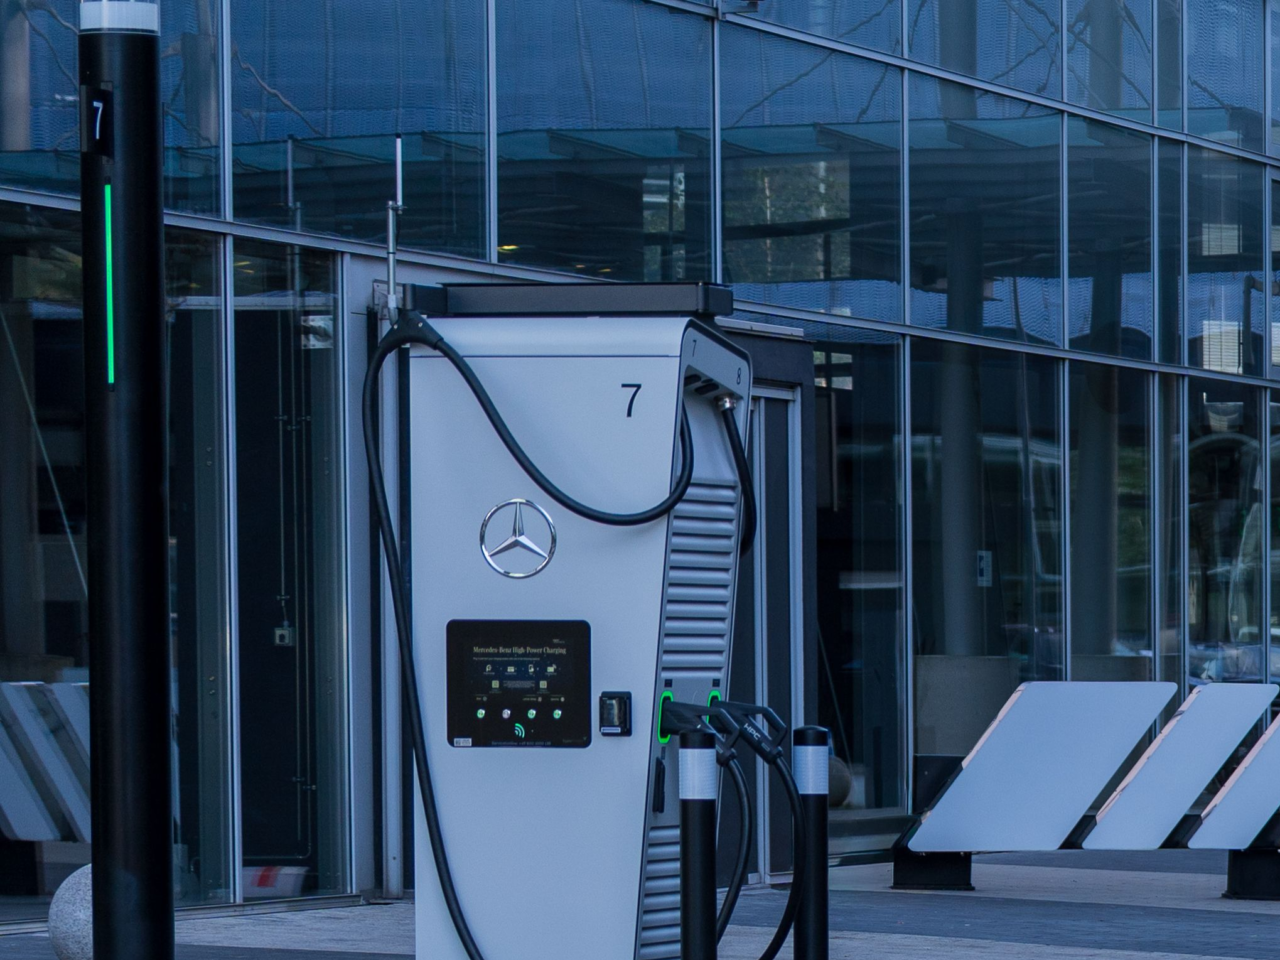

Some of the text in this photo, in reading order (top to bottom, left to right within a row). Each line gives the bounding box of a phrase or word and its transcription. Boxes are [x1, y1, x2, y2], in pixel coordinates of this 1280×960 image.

[93, 101, 103, 140] 7
[692, 339, 697, 357] 7
[737, 367, 742, 385] 8
[621, 383, 642, 418] 7
[743, 722, 761, 740] HPC
